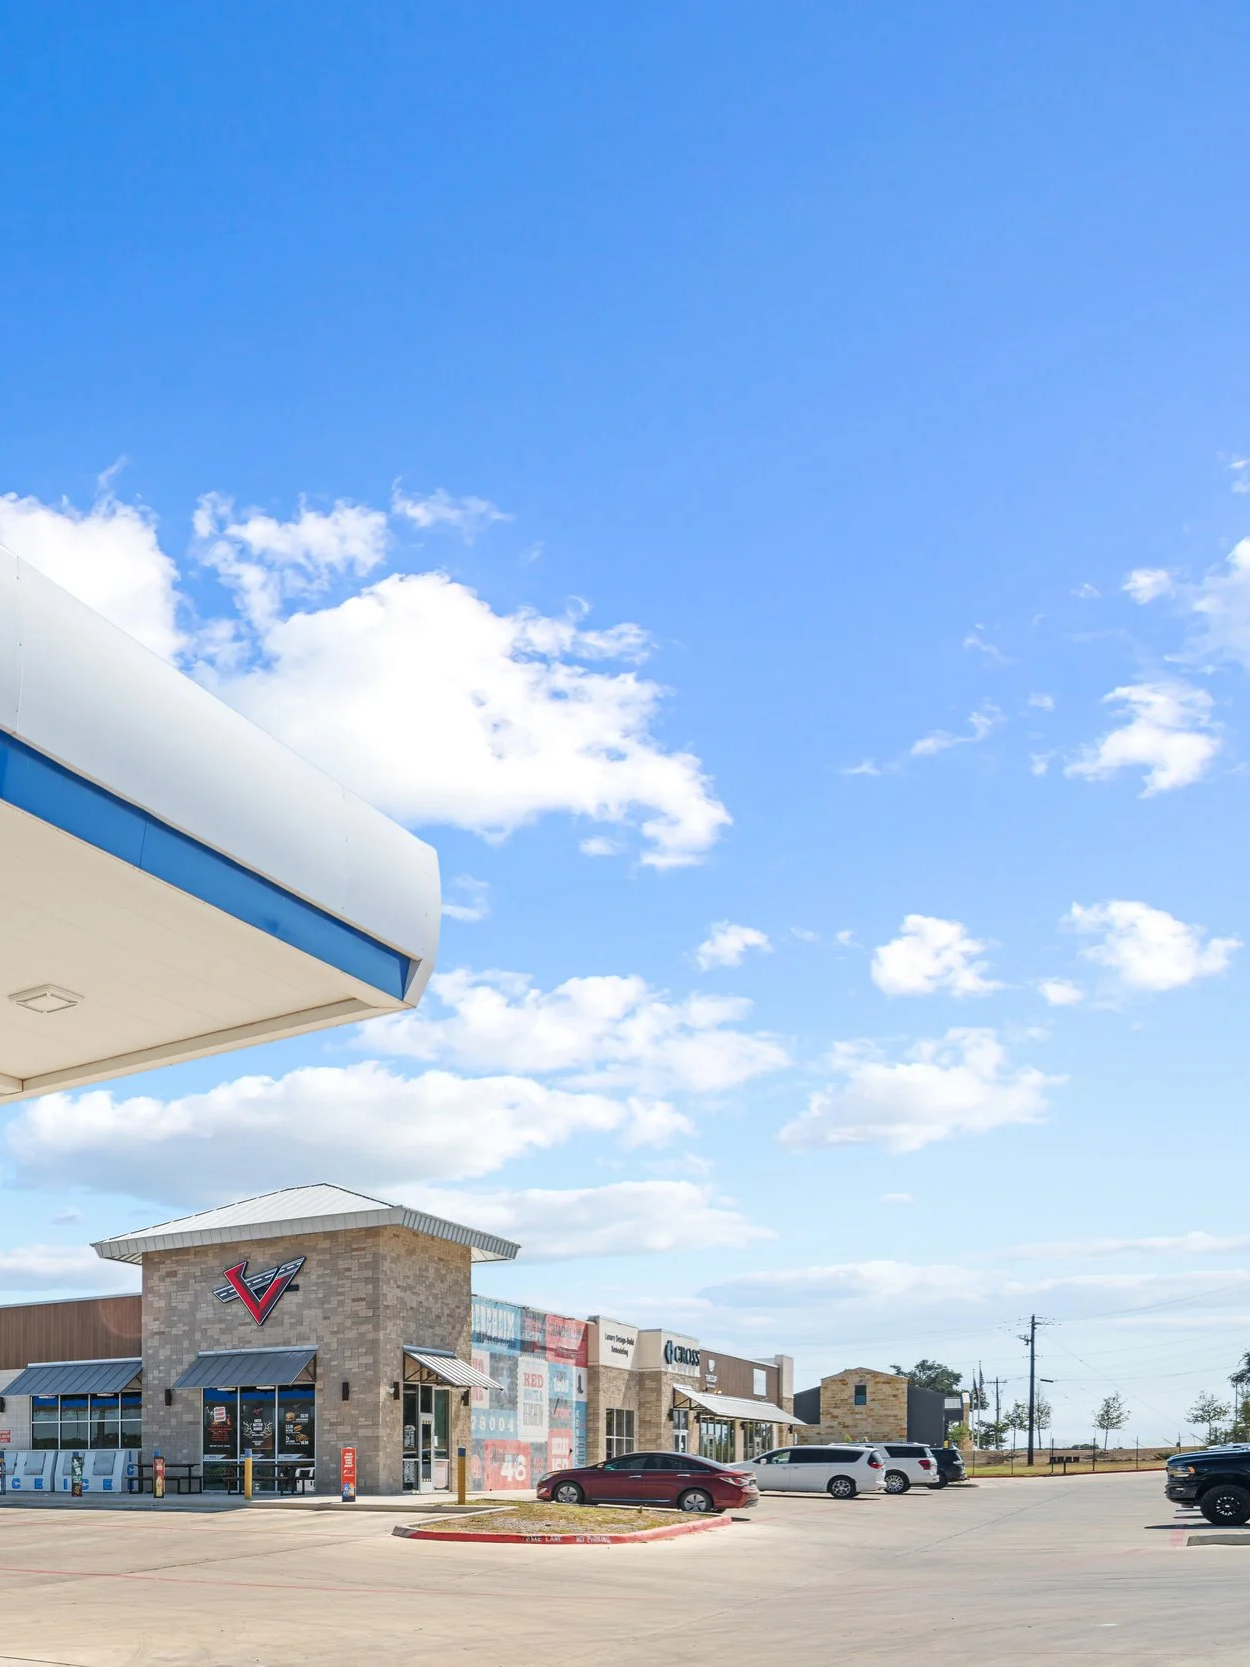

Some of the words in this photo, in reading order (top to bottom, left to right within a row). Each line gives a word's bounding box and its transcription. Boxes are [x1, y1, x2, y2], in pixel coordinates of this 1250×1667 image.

[673, 1345, 700, 1366] CROSS
[523, 1372, 544, 1389] RED
[471, 1416, 515, 1432] 78004
[500, 1454, 527, 1482] 46
[63, 1478, 114, 1490] ICE
[576, 1535, 584, 1543] NO
